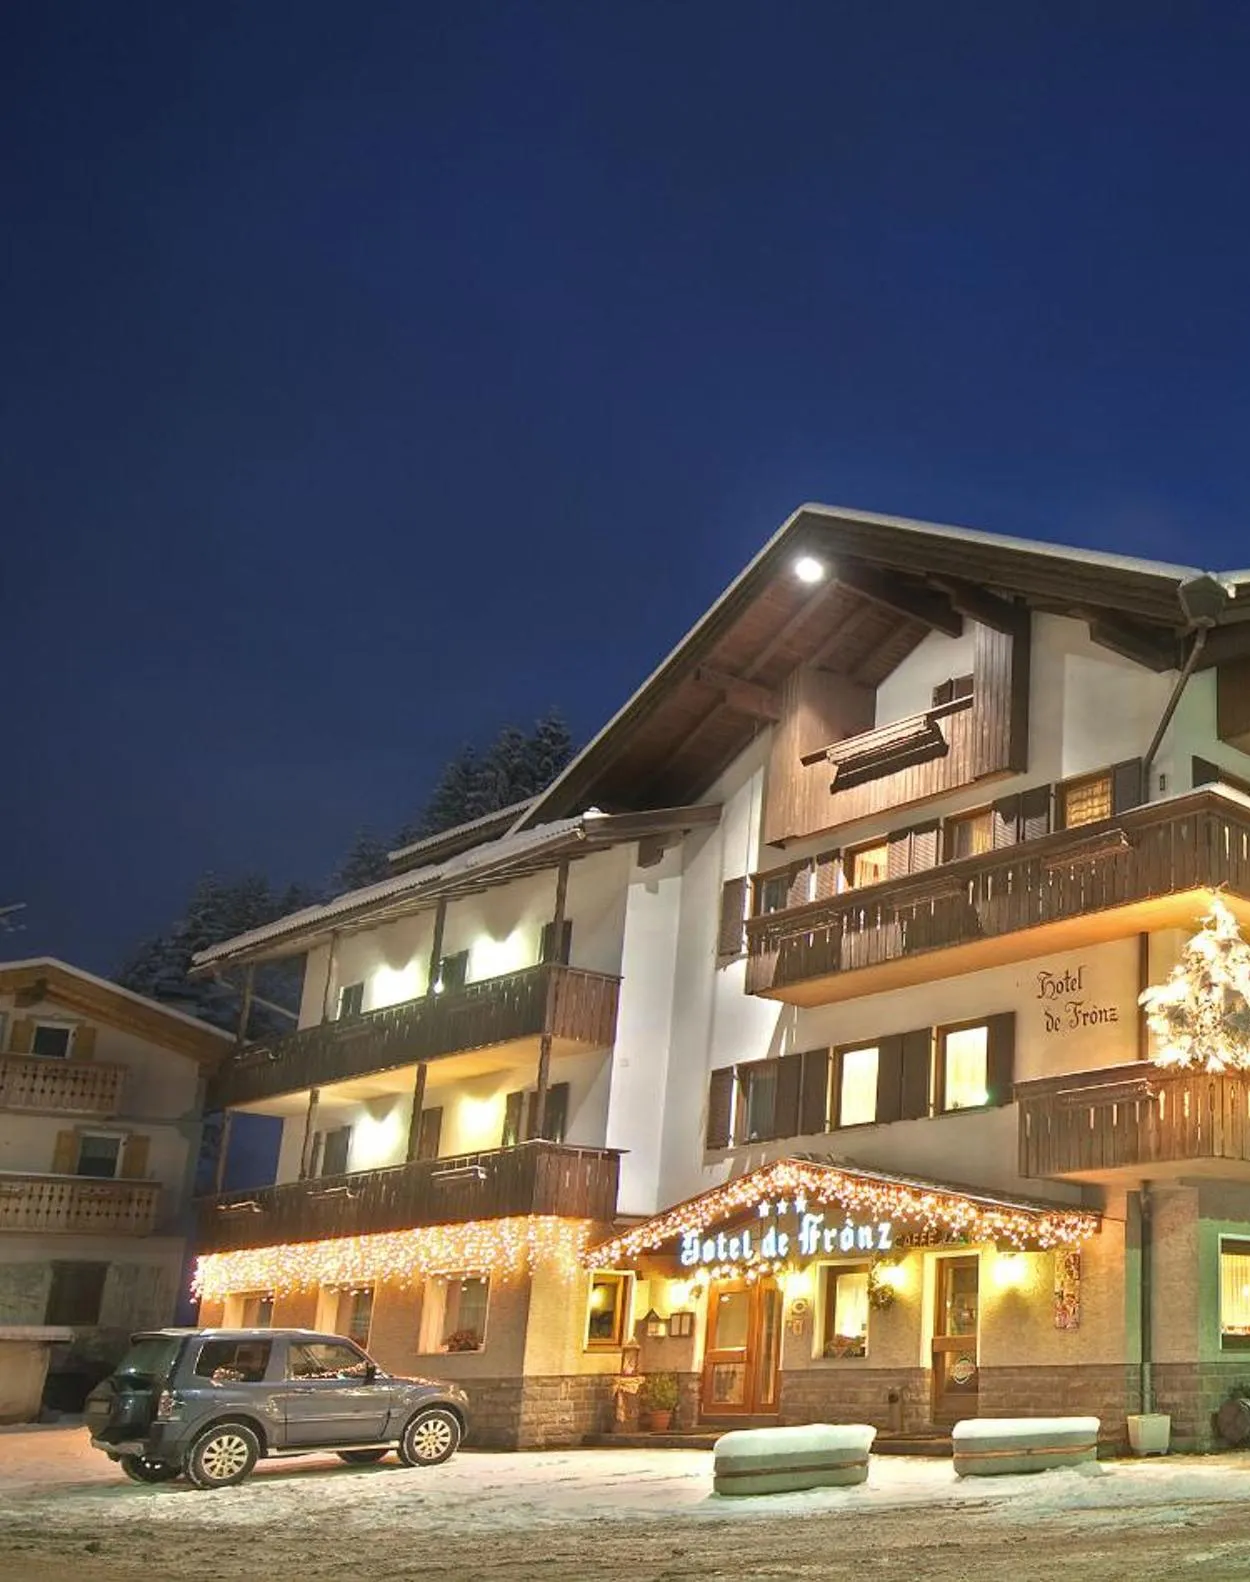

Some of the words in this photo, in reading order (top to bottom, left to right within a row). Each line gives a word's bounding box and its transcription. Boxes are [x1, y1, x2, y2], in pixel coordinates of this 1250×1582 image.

[1037, 965, 1088, 1000] Hotel
[1045, 1010, 1061, 1032] de
[681, 1228, 754, 1265] Hotel
[761, 1226, 790, 1258] de
